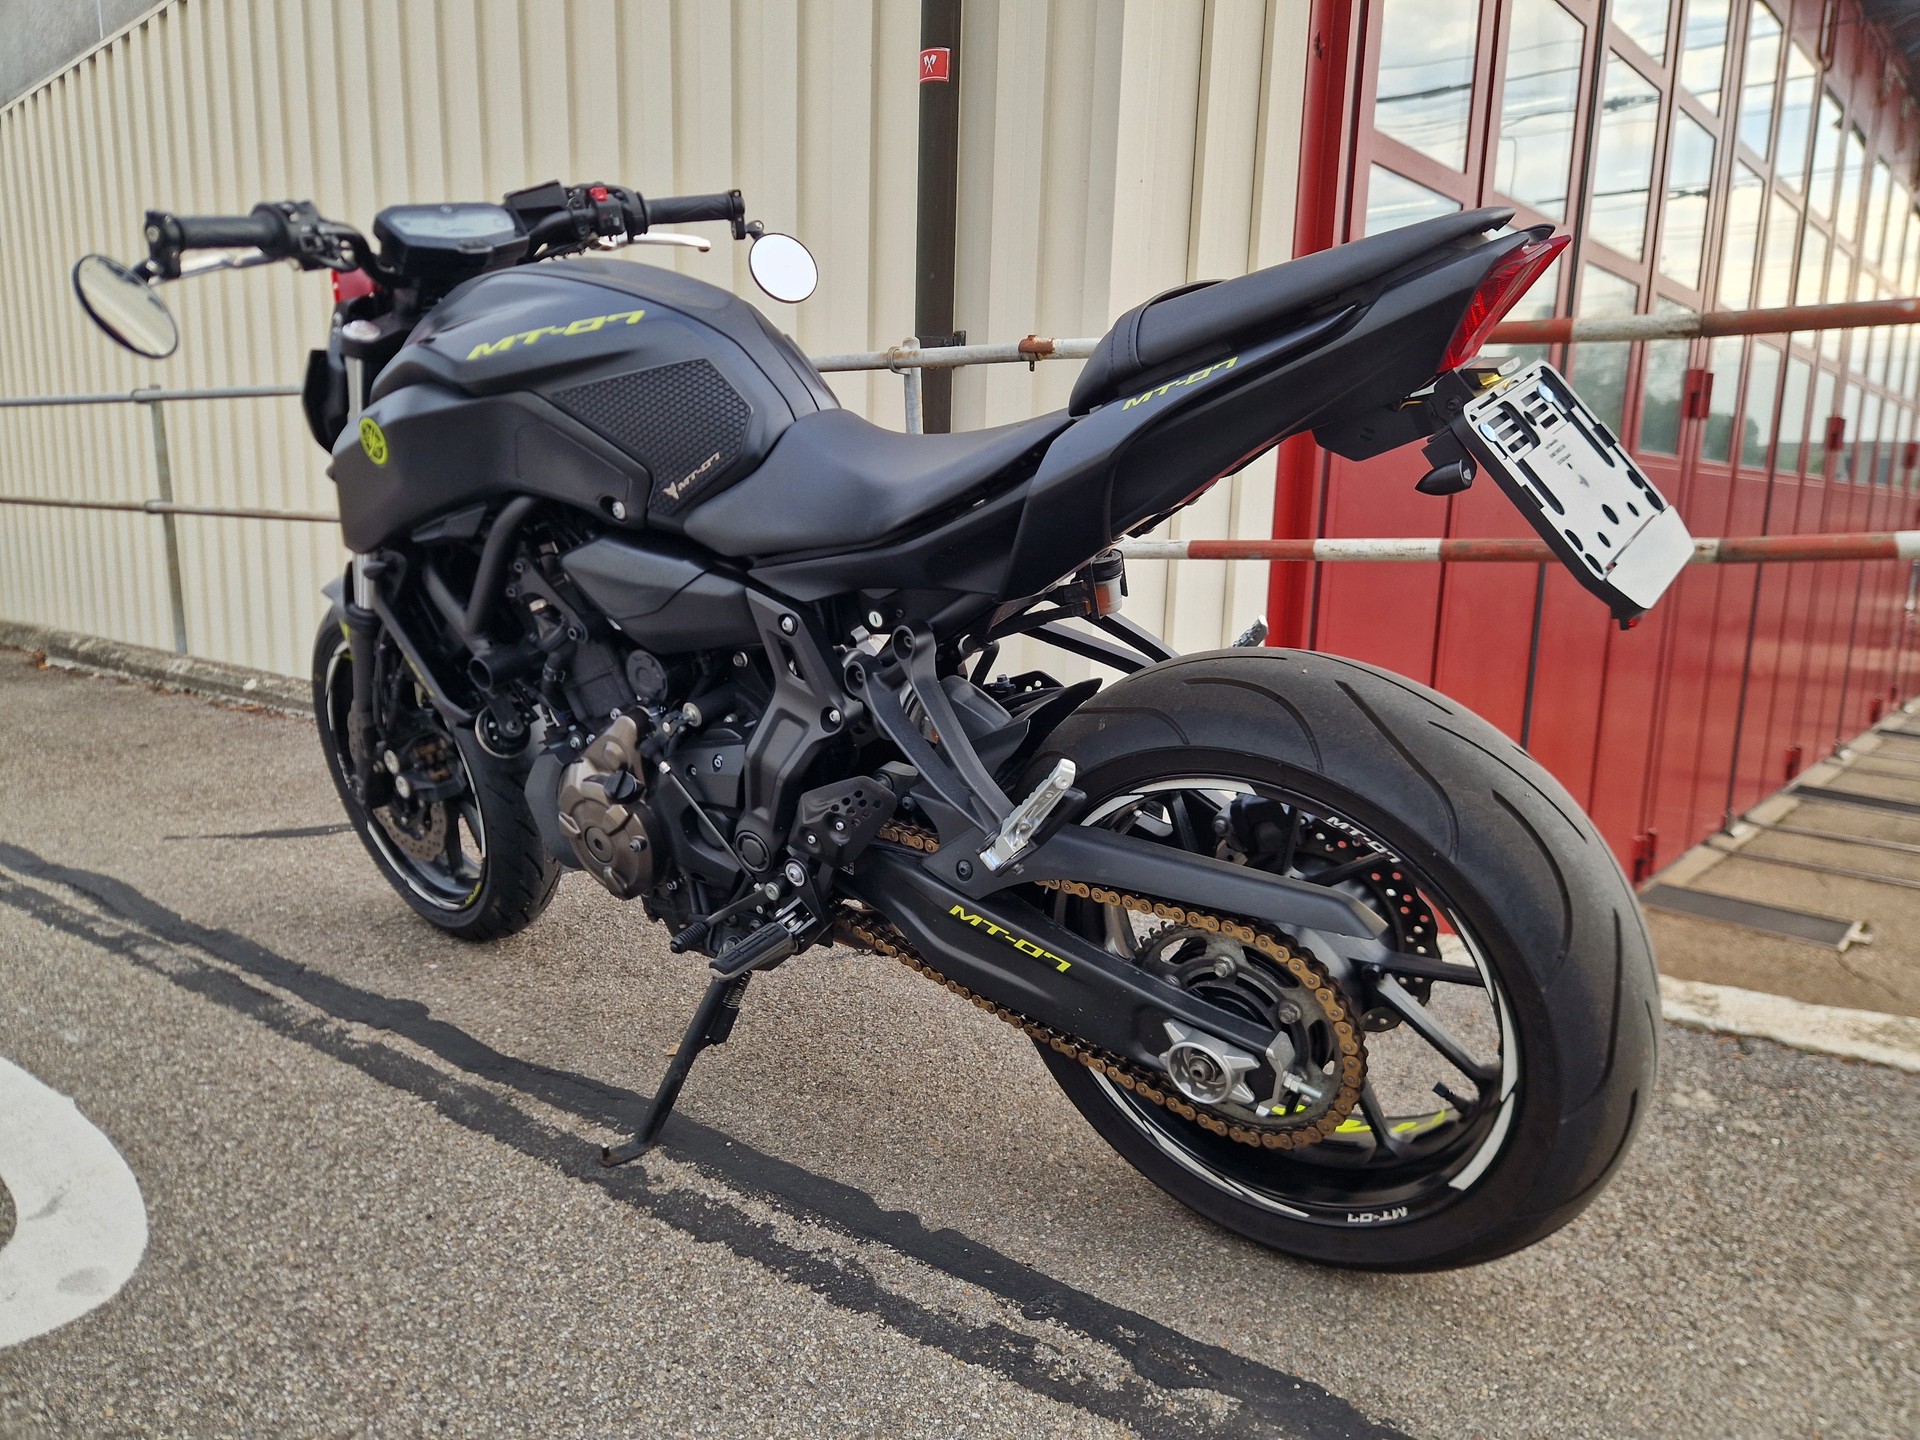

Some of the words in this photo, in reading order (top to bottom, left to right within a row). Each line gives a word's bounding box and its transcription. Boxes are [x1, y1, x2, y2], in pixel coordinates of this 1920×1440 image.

[466, 309, 646, 361] MT-07
[1122, 356, 1239, 412] MT-07
[677, 451, 720, 491] MT-07
[1326, 816, 1402, 863] MT-07
[948, 904, 1072, 973] MT-07
[1347, 1206, 1409, 1223] MT-07
